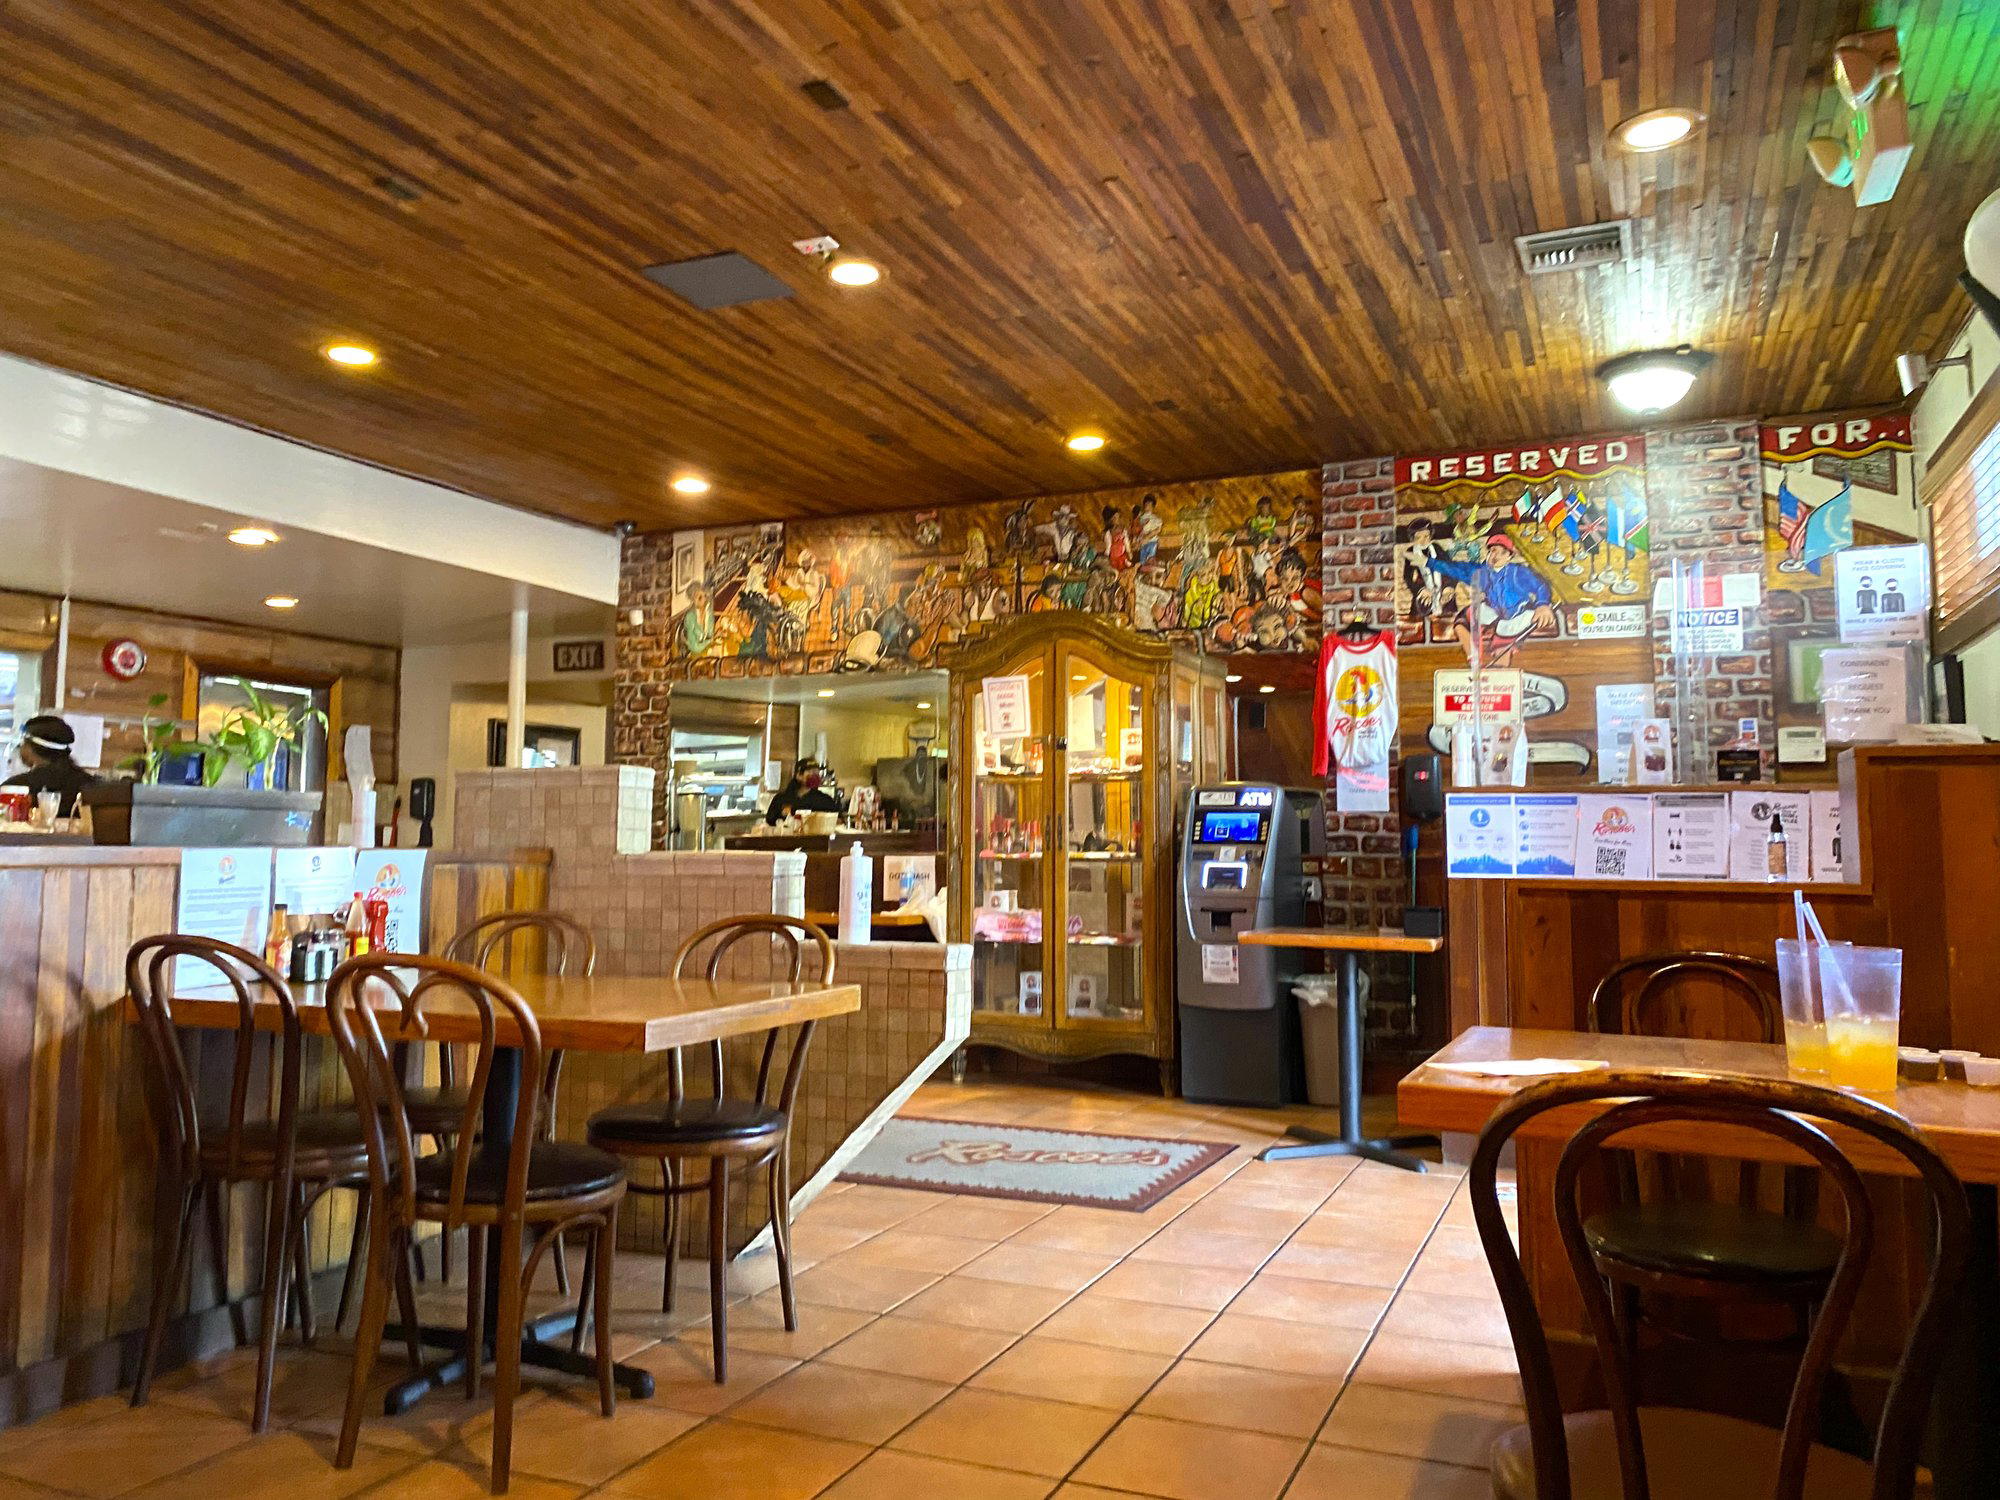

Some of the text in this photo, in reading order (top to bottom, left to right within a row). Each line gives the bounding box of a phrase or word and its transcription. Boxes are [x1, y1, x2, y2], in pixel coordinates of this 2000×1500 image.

[1410, 441, 1629, 483] RESERVED
[1596, 611, 1627, 623] SMILE
[1677, 610, 1738, 627] NOTICE
[557, 645, 598, 669] EXIT
[1240, 791, 1273, 807] ATM
